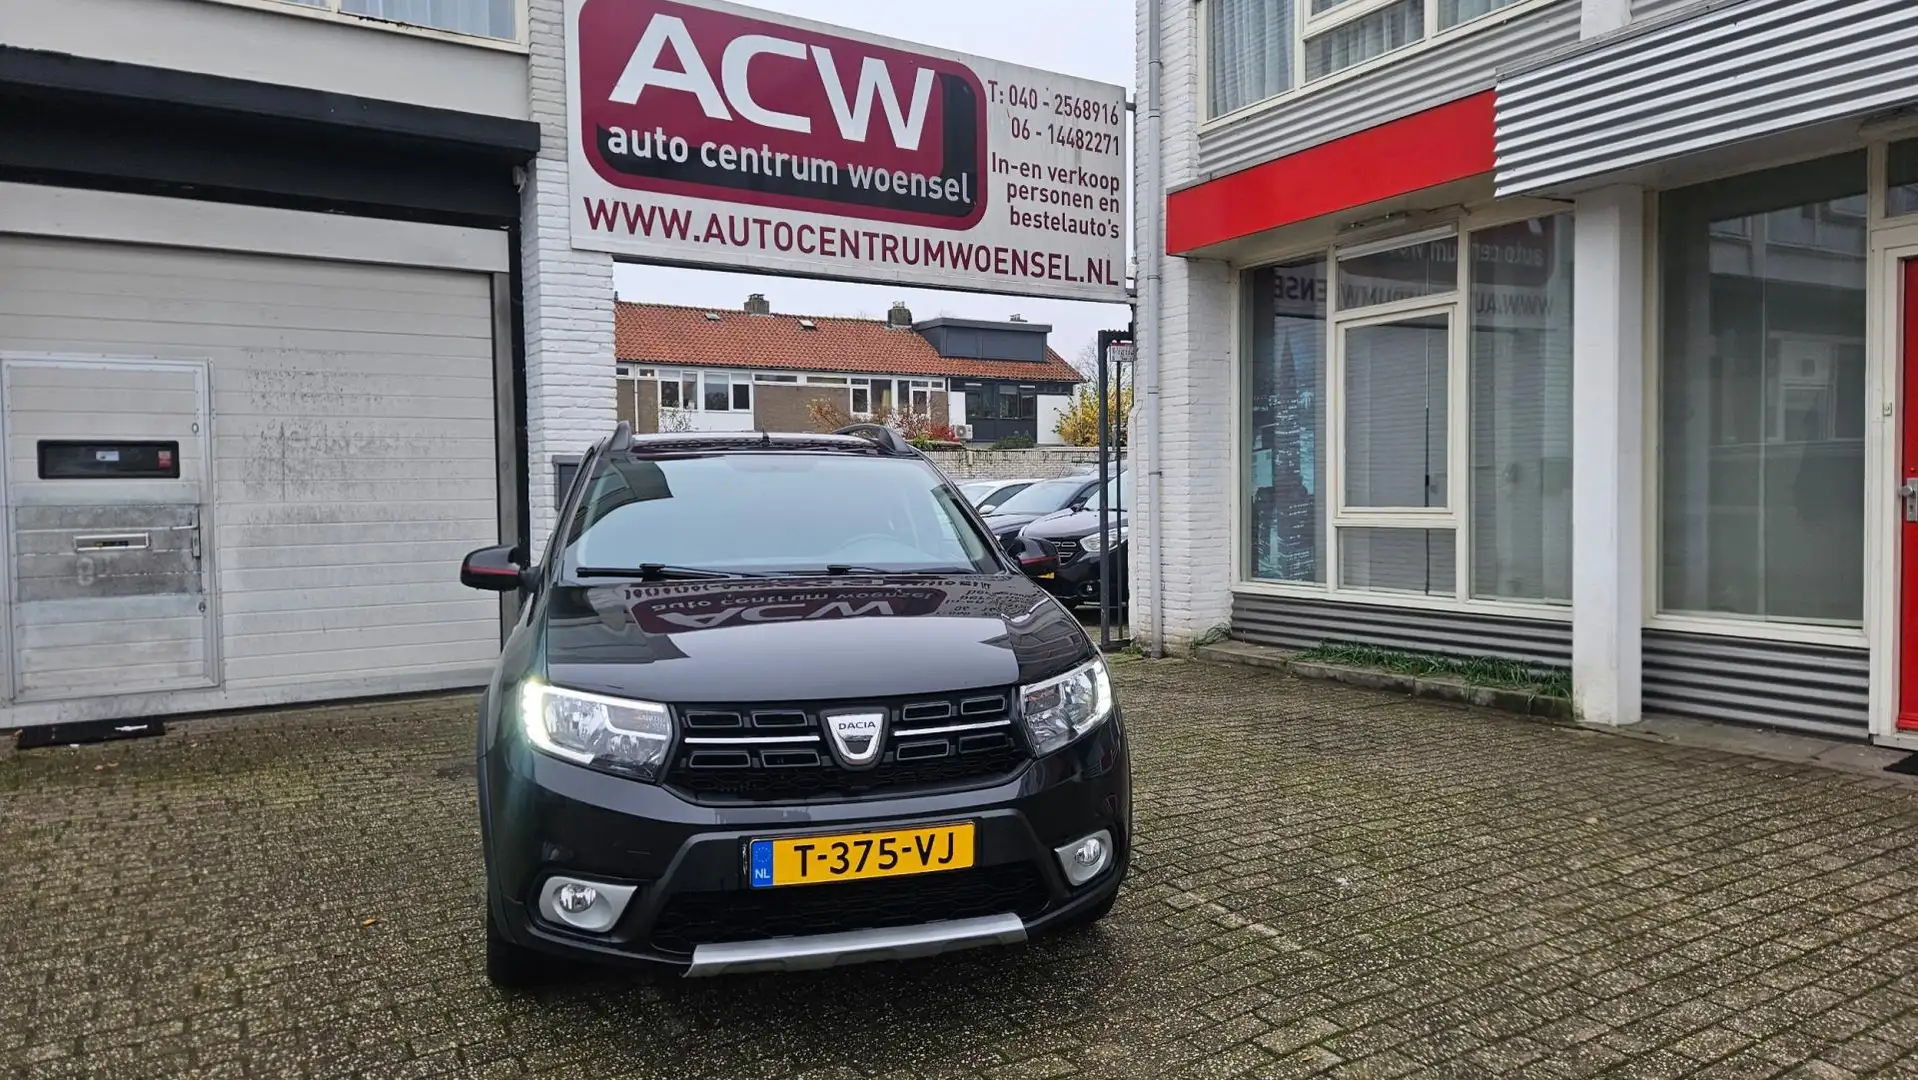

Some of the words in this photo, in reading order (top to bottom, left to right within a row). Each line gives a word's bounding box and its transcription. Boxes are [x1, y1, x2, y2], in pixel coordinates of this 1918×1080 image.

[608, 13, 935, 151] ACW
[987, 80, 1004, 104] T:
[1009, 84, 1038, 110] 040
[1054, 94, 1119, 126] 2568916
[1011, 117, 1031, 140] 06
[1048, 123, 1119, 156] 14482271
[607, 125, 689, 163] auto
[699, 141, 839, 185] centrum
[846, 163, 972, 204] woensel
[992, 152, 1042, 180] In-en
[1048, 166, 1120, 196] verkoop
[1007, 182, 1093, 210] personen
[1099, 196, 1120, 213] en
[583, 196, 1119, 286] WWW.AUTOCENTRUMWOENSEL.NL
[1010, 205, 1120, 239] bestelauto's
[837, 720, 877, 731] DACIA
[754, 868, 771, 880] NL
[793, 832, 955, 877] T-375-VJ
